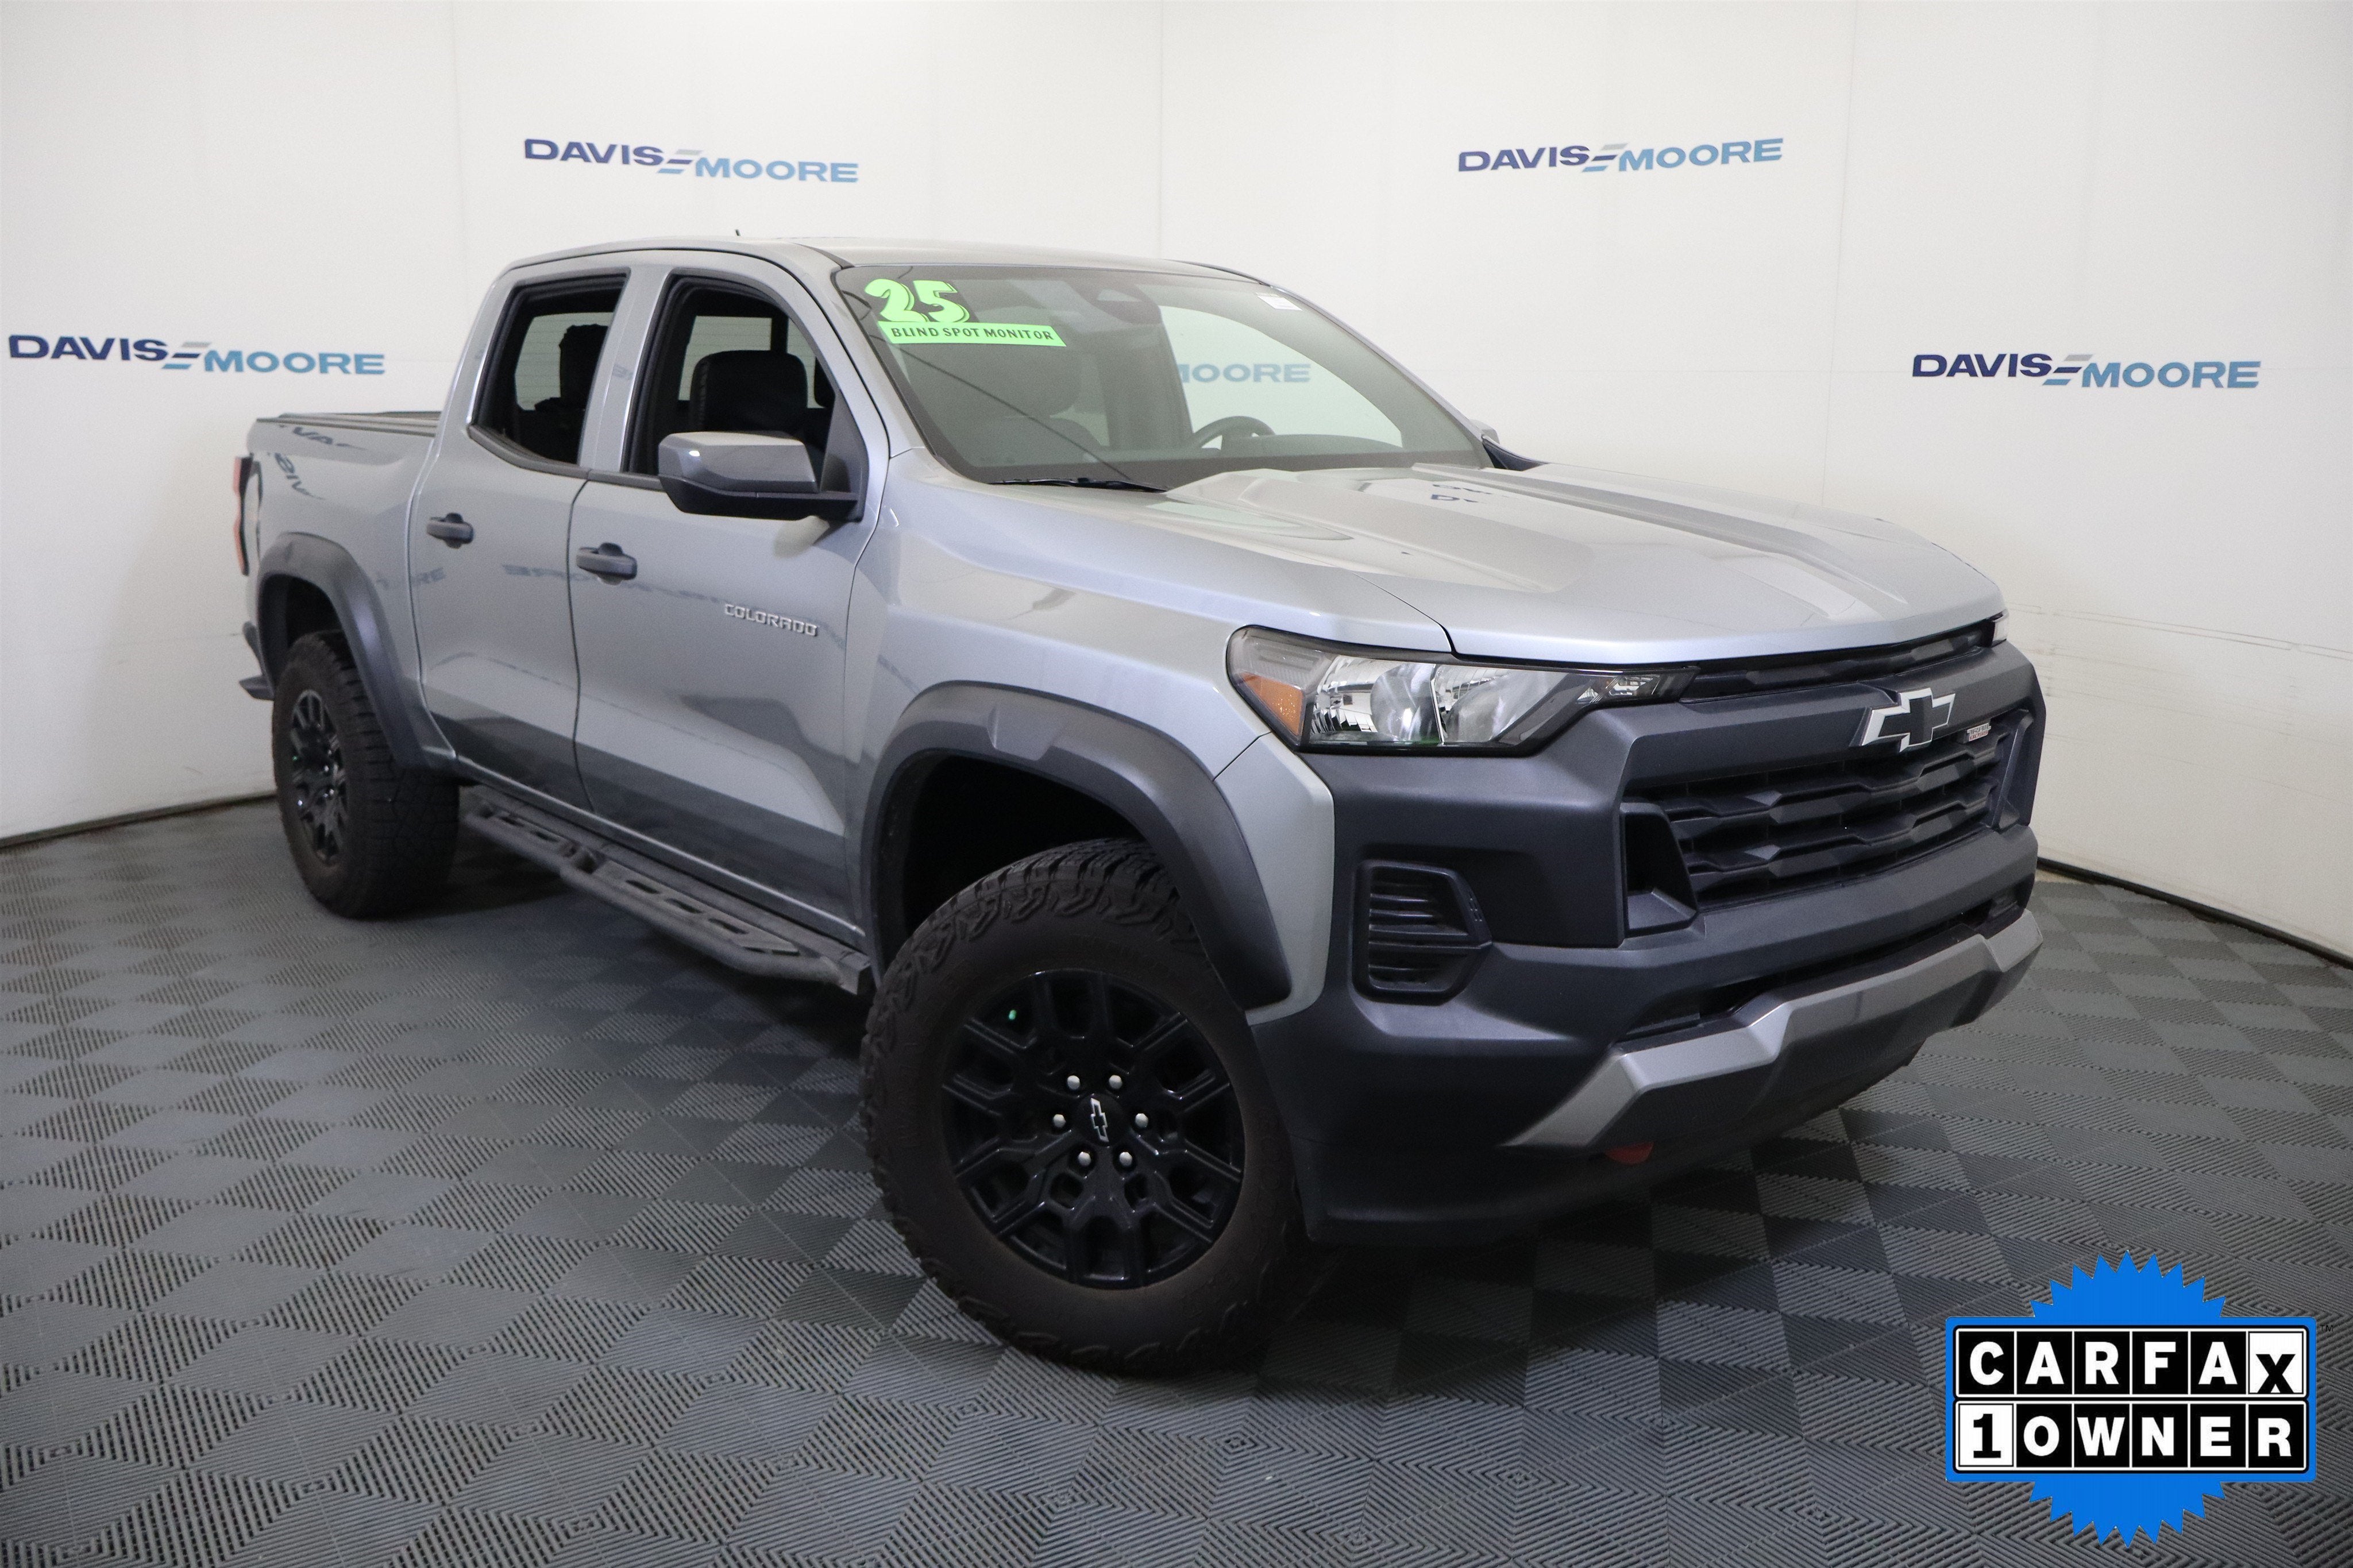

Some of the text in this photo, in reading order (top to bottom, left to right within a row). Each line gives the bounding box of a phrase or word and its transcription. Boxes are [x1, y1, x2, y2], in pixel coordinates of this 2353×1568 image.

[524, 138, 858, 183] DAVIS MOORE
[1459, 138, 1783, 172] DAVIS MOORE
[864, 279, 970, 322] 25
[891, 327, 1054, 340] BLIND SPOT MONITOR
[9, 335, 385, 374] DAVIS MOORE
[1912, 353, 2261, 388] DAVIS MOORE
[724, 604, 817, 636] COLORADO
[1967, 723, 1991, 735] TRAIL
